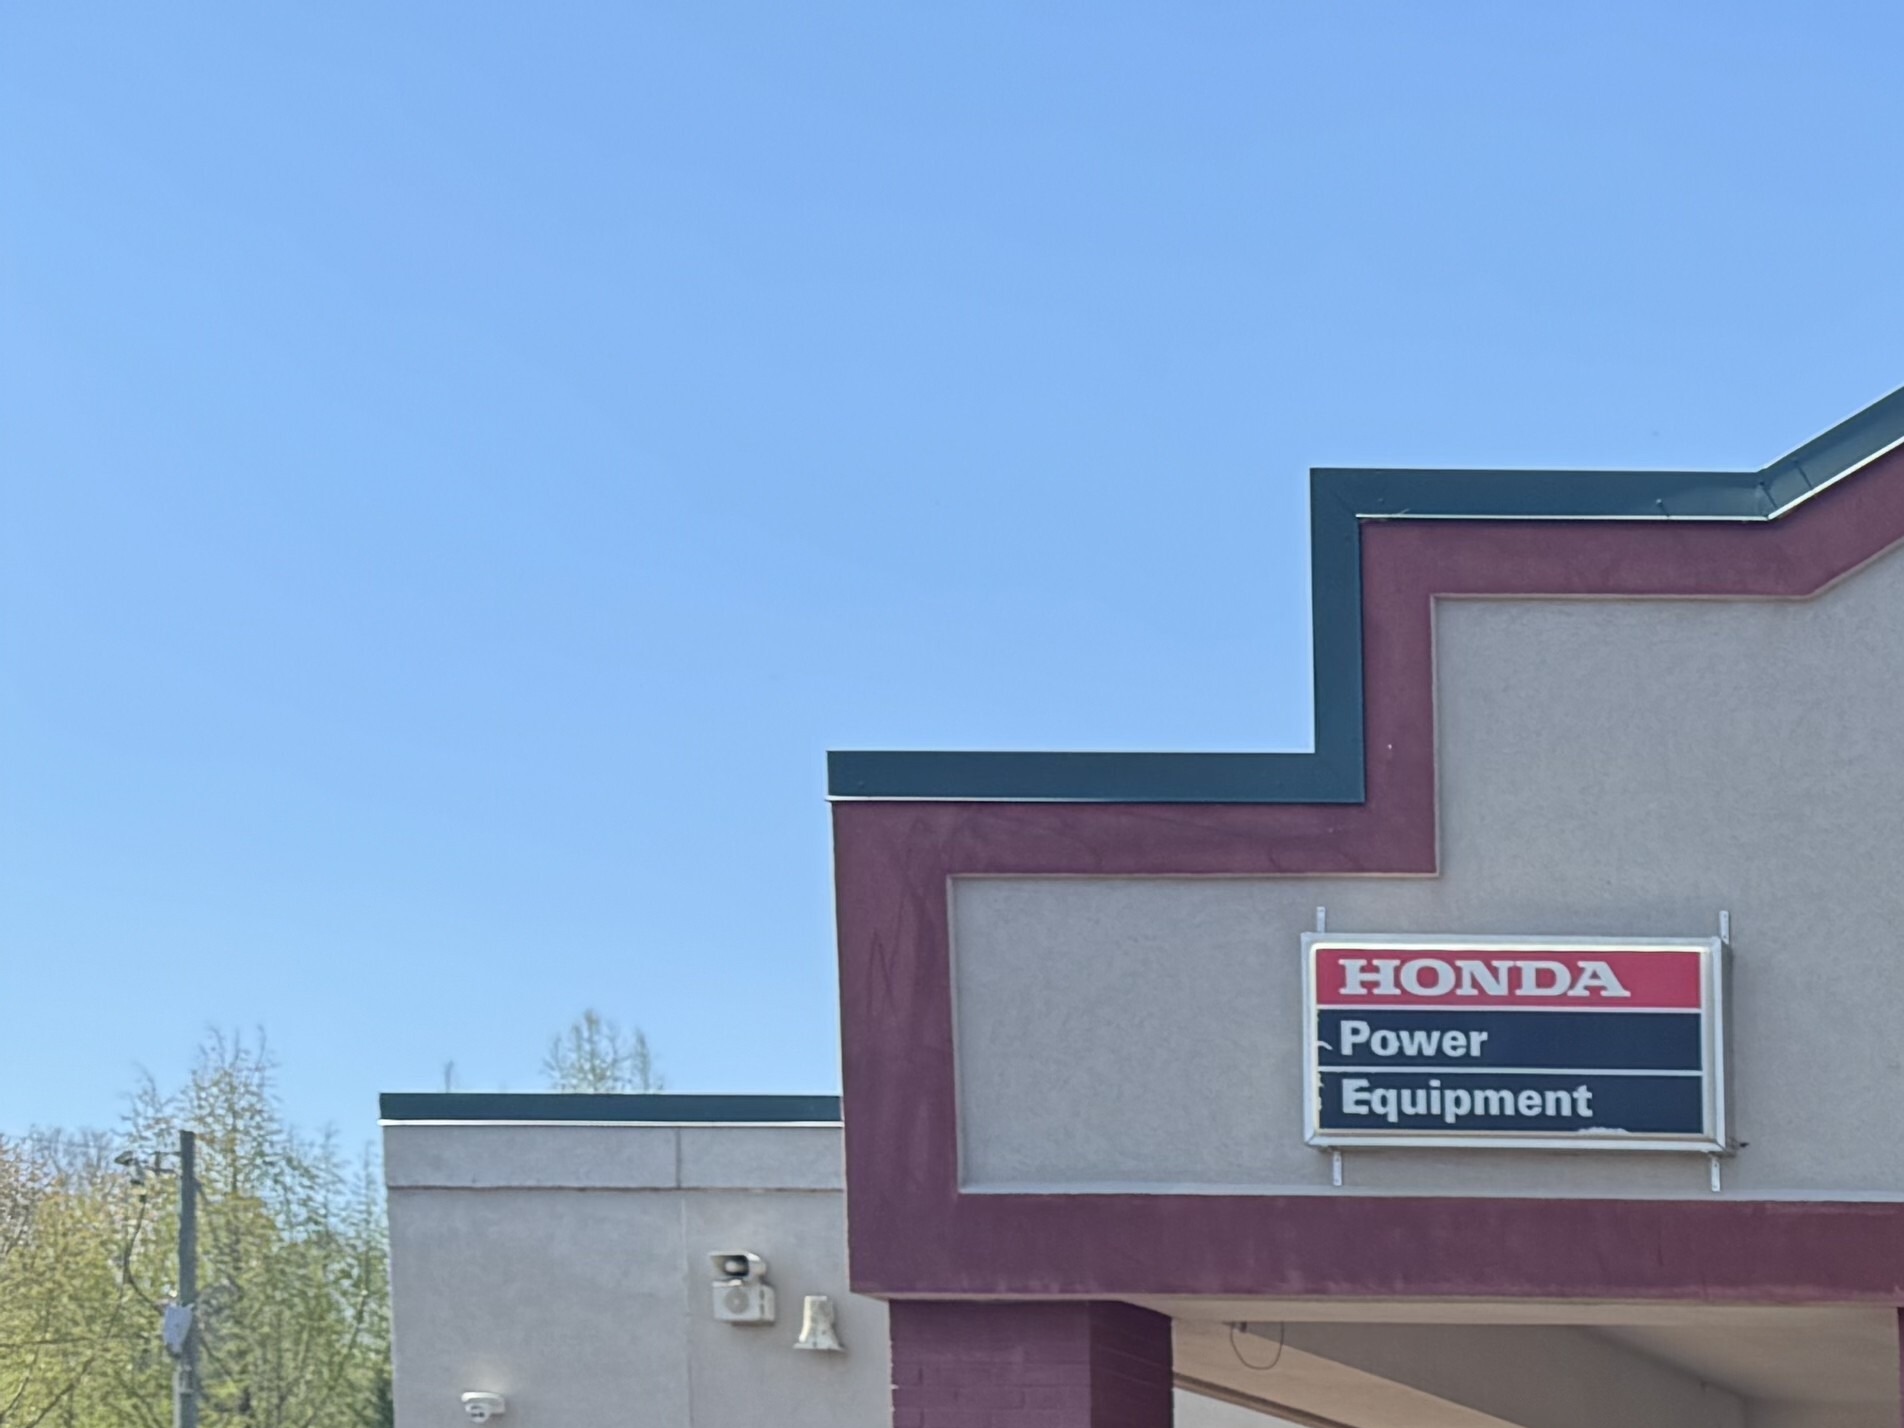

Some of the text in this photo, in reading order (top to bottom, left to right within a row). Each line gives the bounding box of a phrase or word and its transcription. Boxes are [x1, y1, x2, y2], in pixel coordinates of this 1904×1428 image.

[1338, 958, 1631, 998] HONDA
[1340, 1019, 1488, 1057] Power
[1341, 1078, 1593, 1123] Equipment
